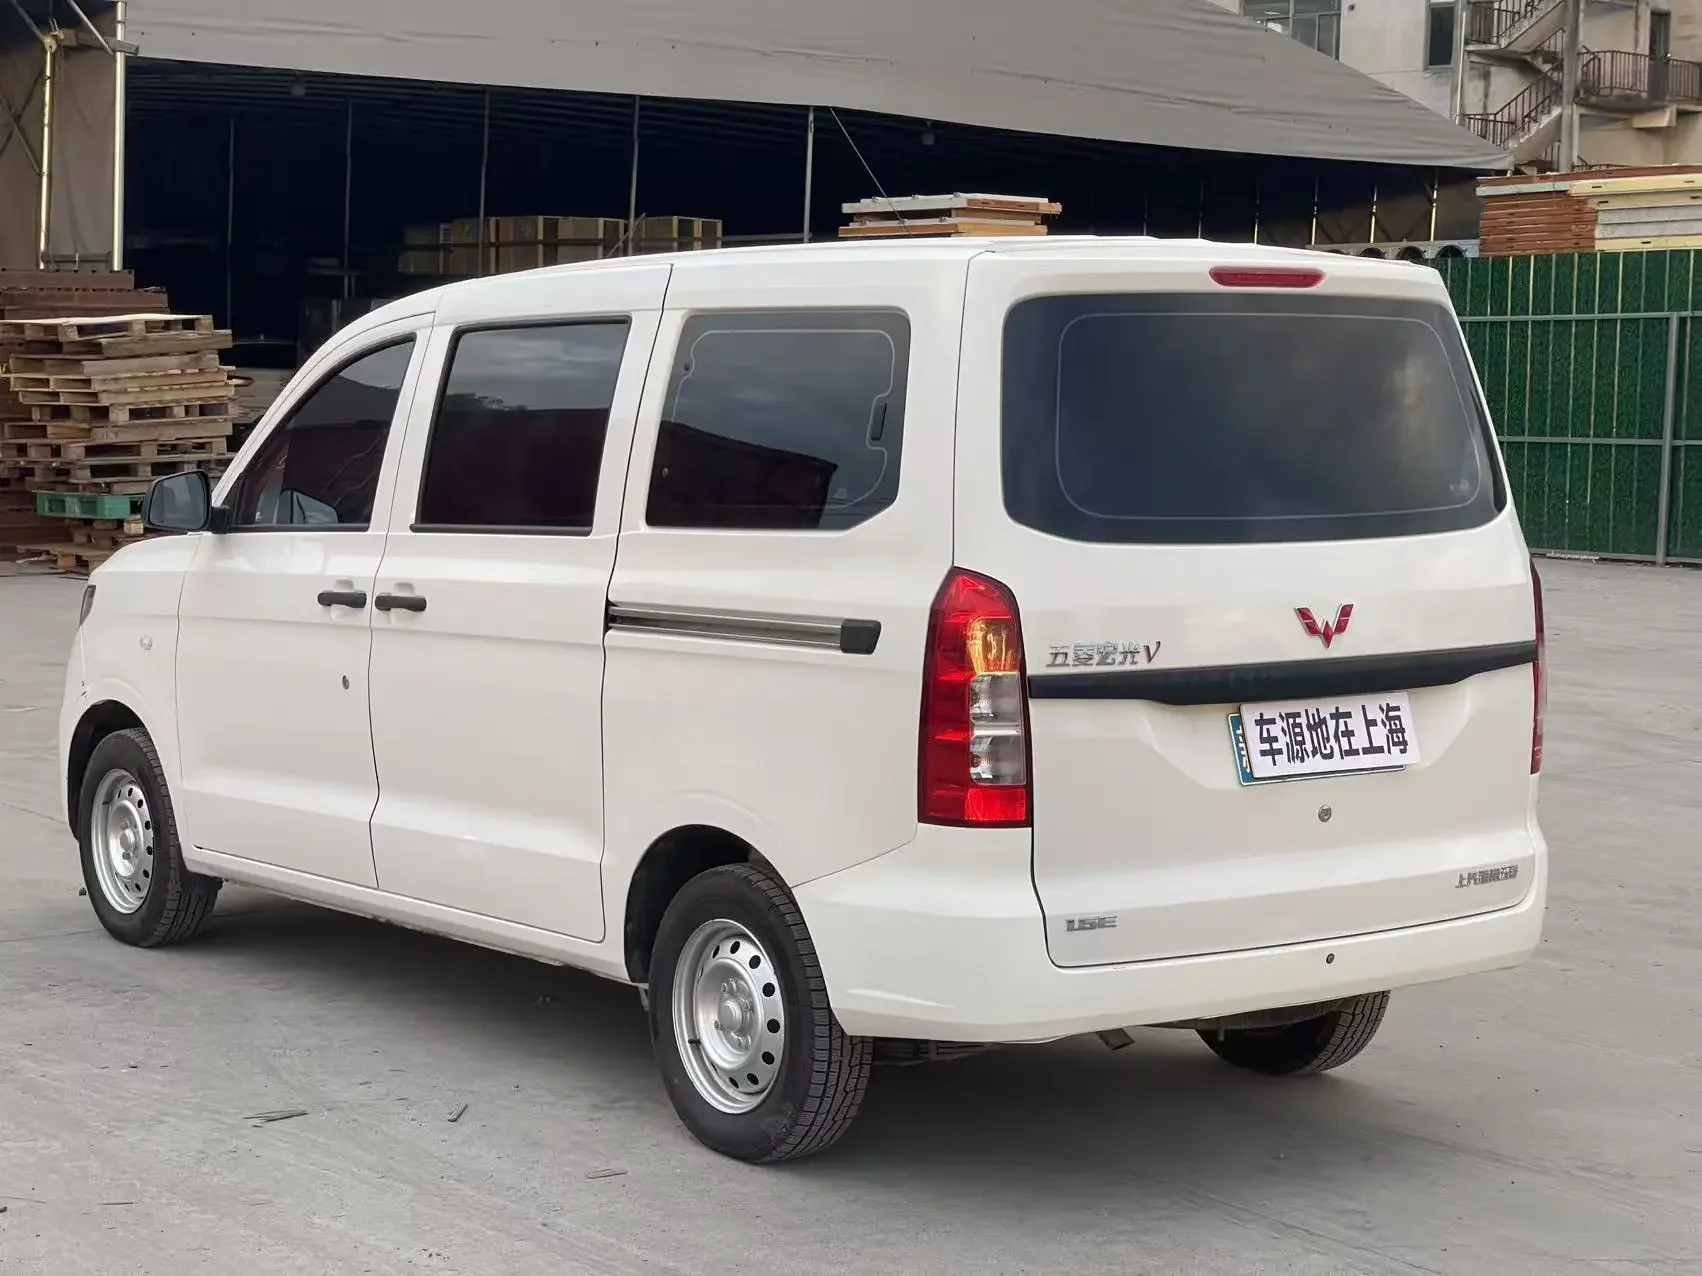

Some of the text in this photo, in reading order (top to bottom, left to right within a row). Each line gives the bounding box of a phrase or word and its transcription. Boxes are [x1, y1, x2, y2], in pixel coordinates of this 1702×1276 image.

[1254, 702, 1409, 767] 车源地在上海
